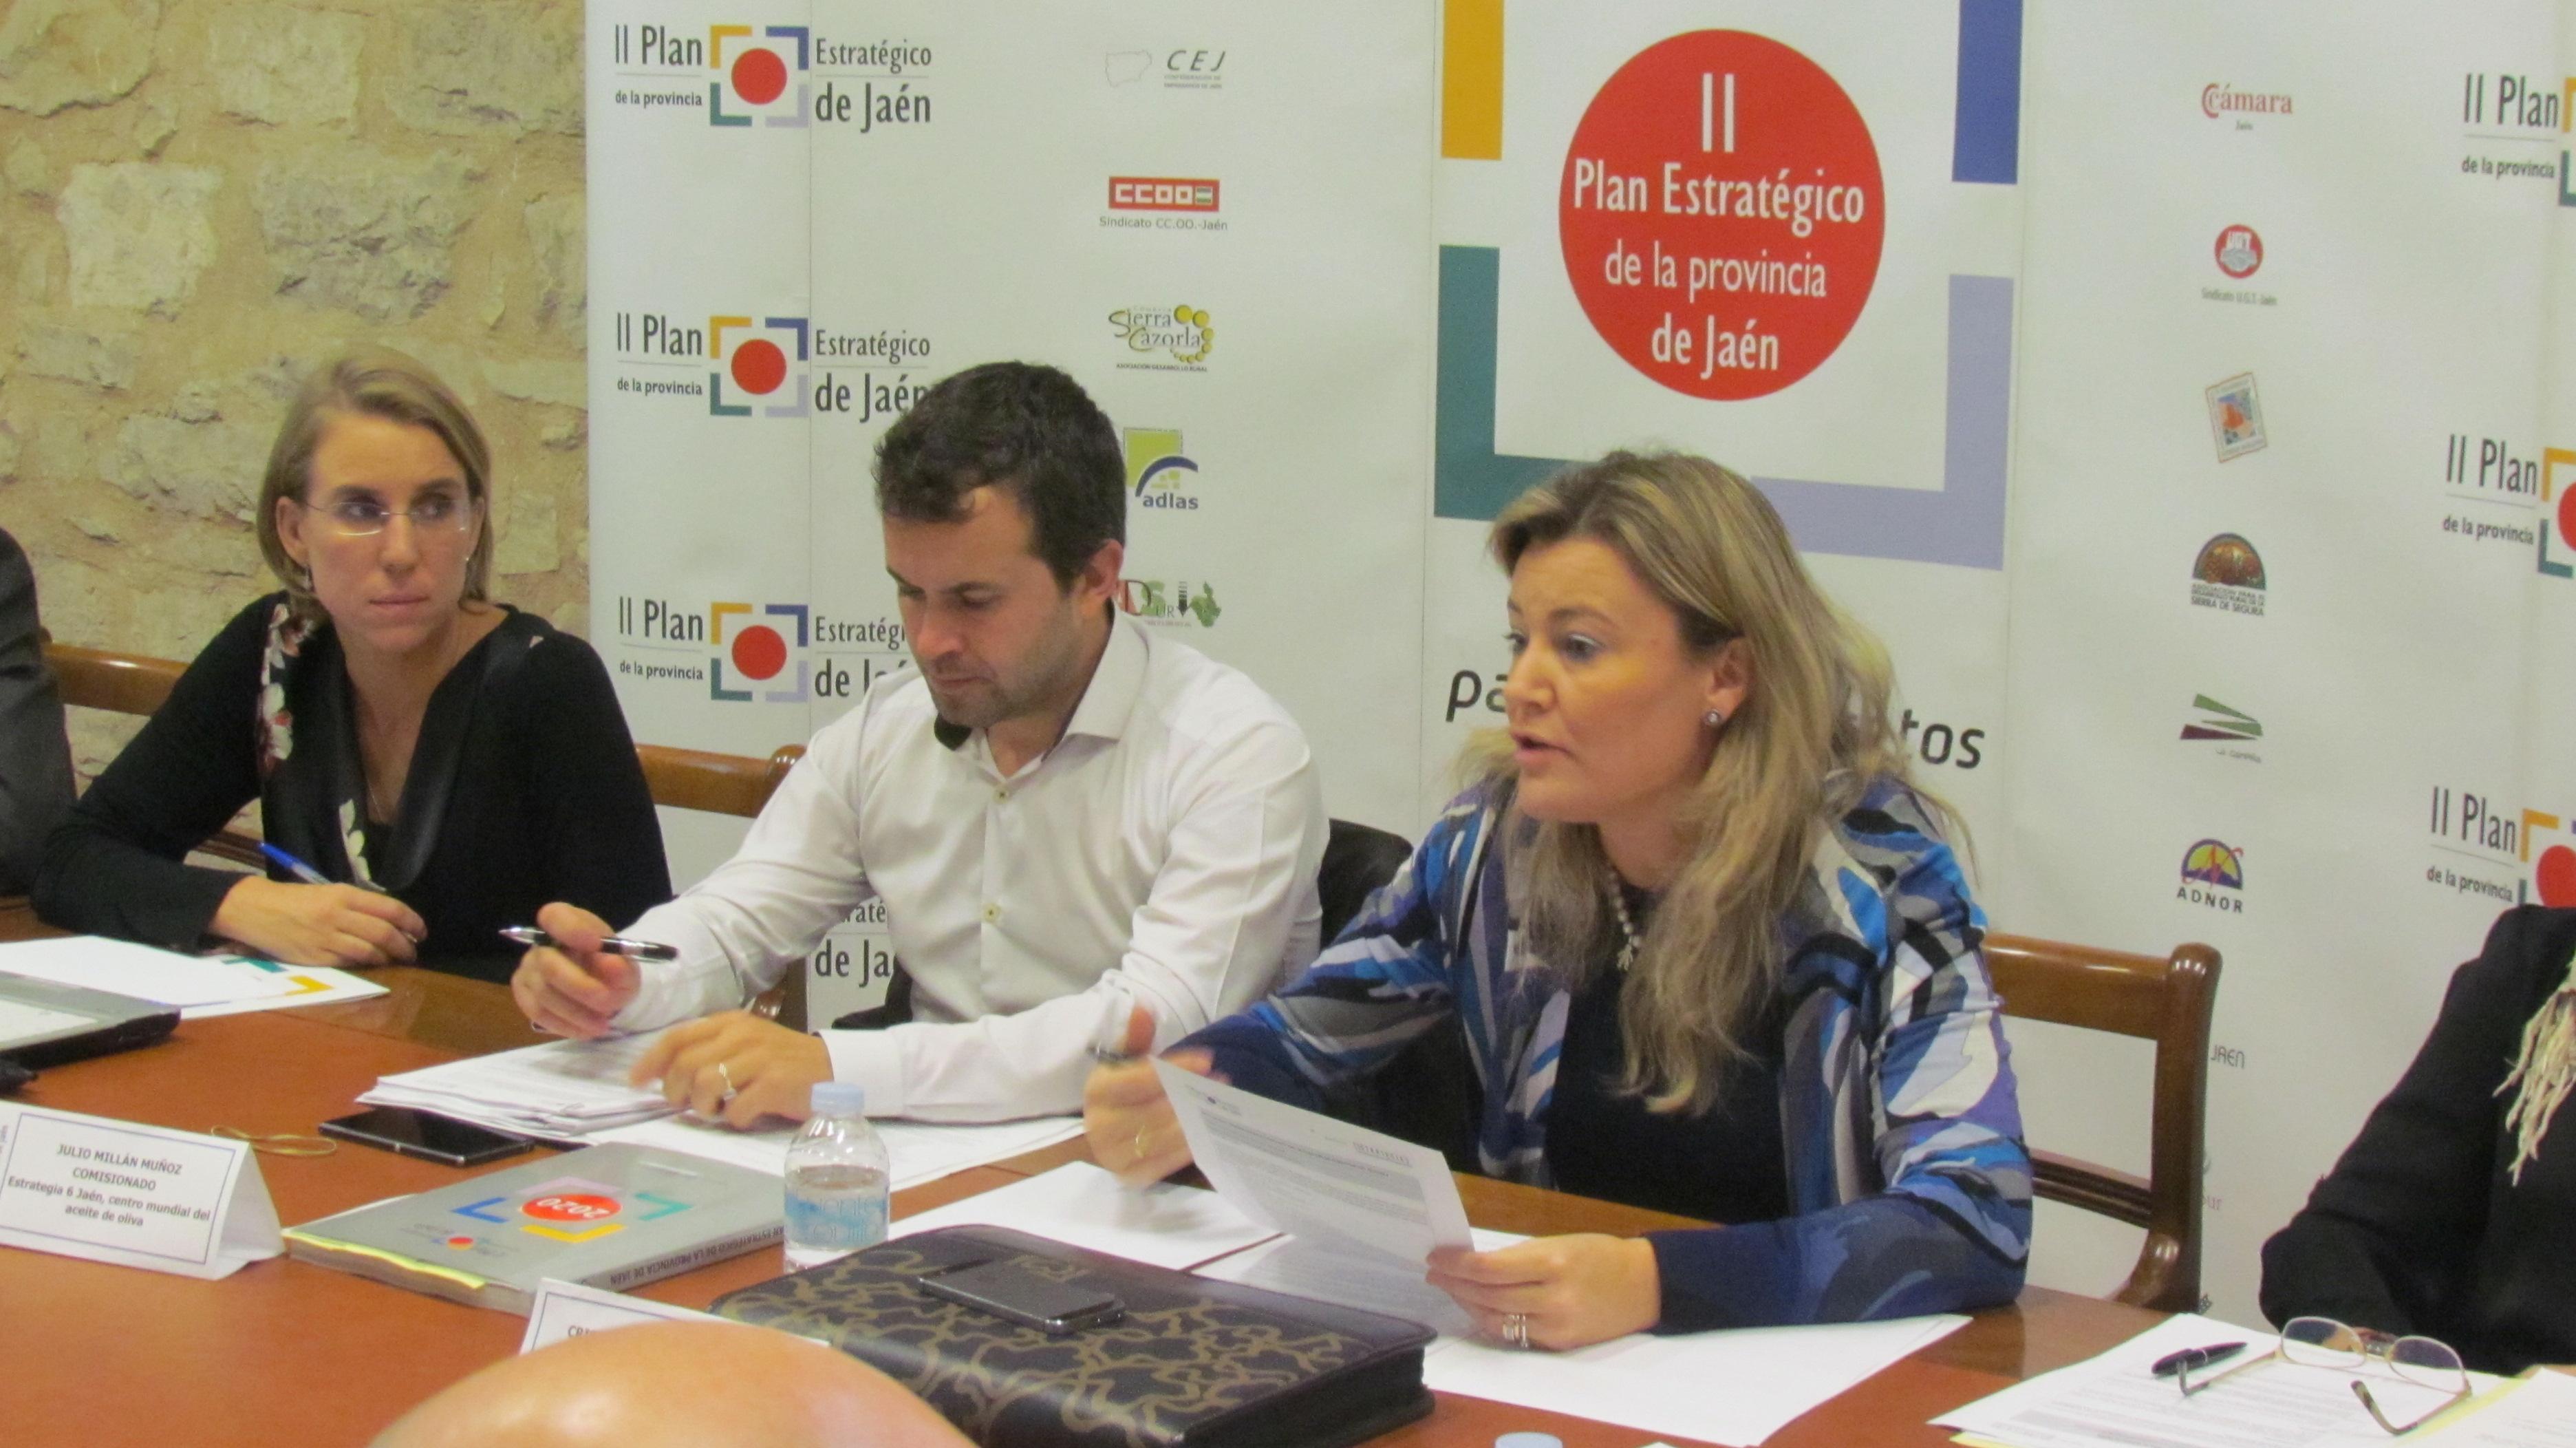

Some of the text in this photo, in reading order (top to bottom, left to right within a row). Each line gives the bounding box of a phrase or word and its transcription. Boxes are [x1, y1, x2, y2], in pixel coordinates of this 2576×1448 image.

[615, 25, 702, 65] II Plan
[816, 38, 932, 74] Estratégico
[615, 91, 702, 108] de la provincia
[815, 83, 931, 133] de Jaén
[1702, 72, 1735, 153] II
[2465, 73, 2559, 127] II Plan
[2461, 155, 2555, 180] de la provincia
[1115, 182, 1194, 205] CCOO
[1574, 158, 1865, 238] Plan Estratégico
[1099, 215, 1152, 228] Sindicato
[1604, 238, 1827, 304] de la provincia
[617, 312, 702, 355] II Plan
[815, 329, 931, 365] Estratégico
[1651, 312, 1779, 381] de Jaén
[617, 376, 702, 397] de la provincia
[815, 373, 850, 412] de
[2446, 434, 2537, 496] II Plan
[1142, 491, 1199, 510] adlas
[2443, 515, 2534, 546] de la provincia
[619, 596, 703, 641] II Plan
[815, 615, 905, 650] Estratégi
[619, 660, 703, 681] de la provincia
[815, 659, 850, 697] de
[2432, 786, 2516, 854] II Plan
[2176, 886, 2243, 913] ADNOR
[2426, 866, 2513, 903] de la provincia
[815, 939, 891, 988] de Ja
[57, 1143, 182, 1175] JULIO MILLÁN MUÑOZ
[72, 1167, 157, 1191] COMISIONADO
[8, 1175, 211, 1222] Estrategia 6 Jaén, centro mundial del
[65, 1204, 144, 1227] aceite de oliva
[536, 1197, 610, 1218] 2020
